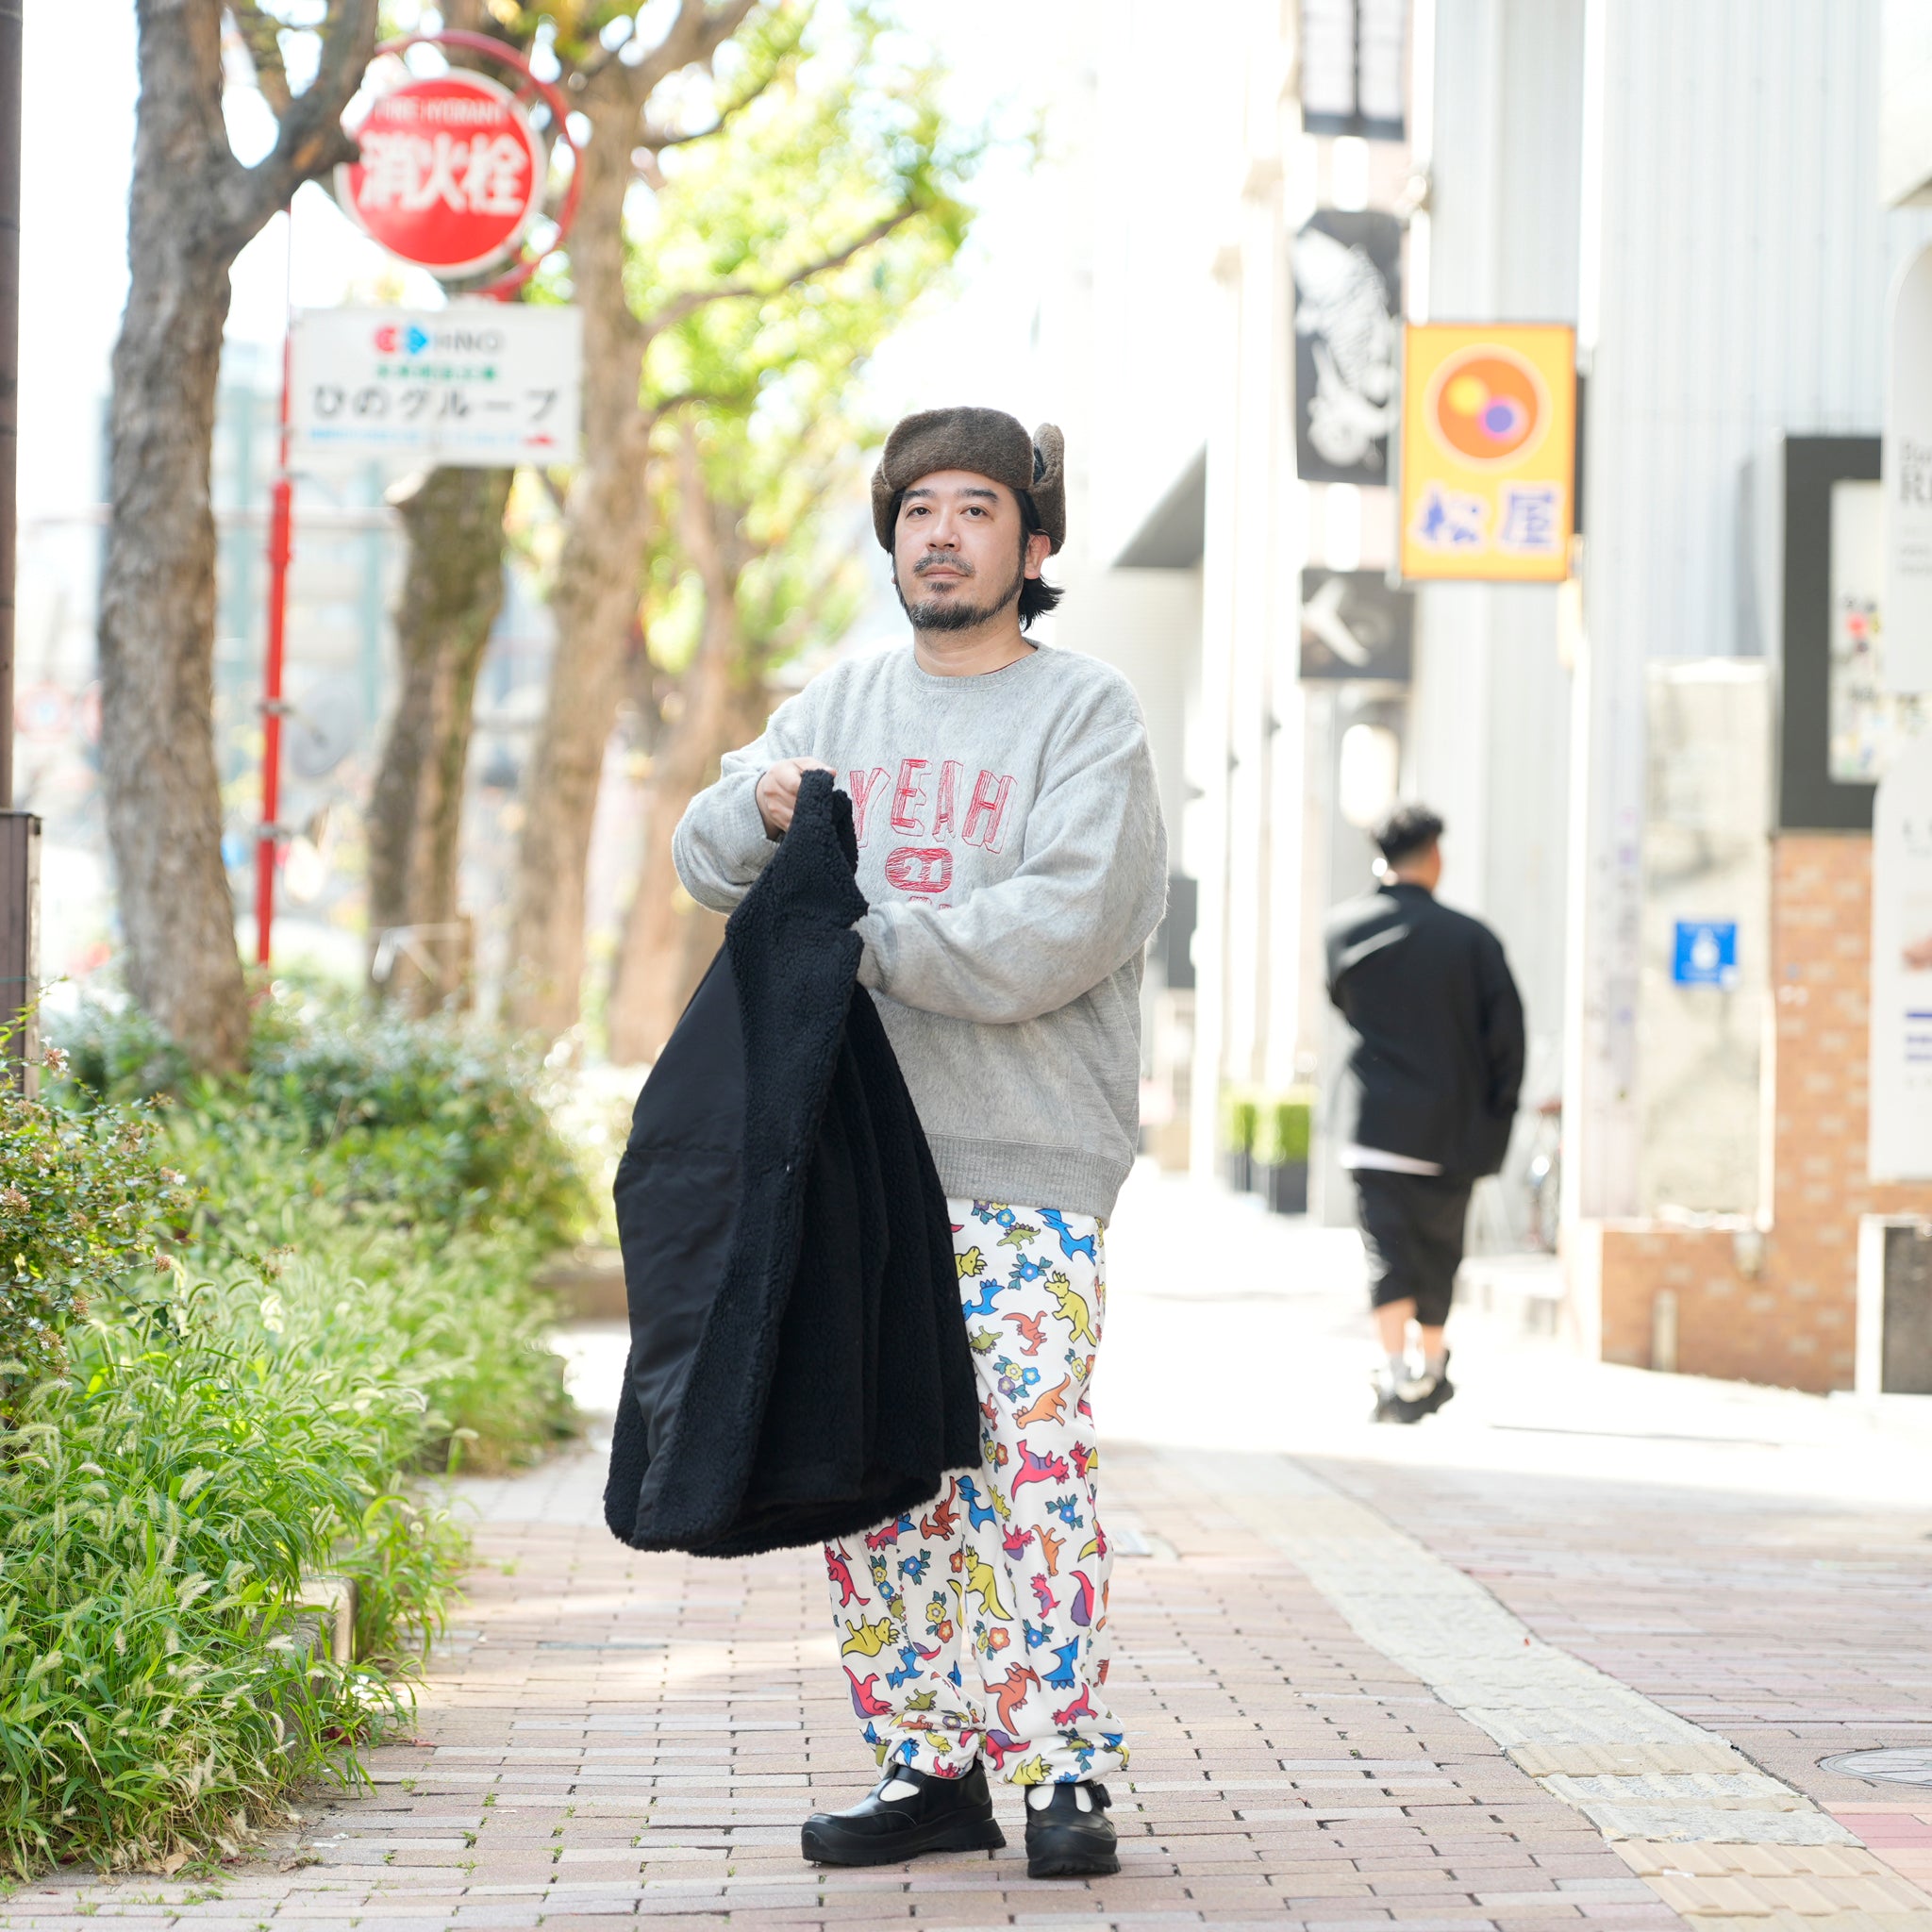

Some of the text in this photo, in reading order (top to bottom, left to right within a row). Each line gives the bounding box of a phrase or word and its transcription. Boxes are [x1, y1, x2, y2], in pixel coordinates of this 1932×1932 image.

[358, 131, 527, 217] 消火栓
[312, 384, 558, 421] ひのグループ
[1414, 485, 1563, 551] 松屋
[850, 758, 1018, 854] YEAH
[901, 857, 944, 883] 21
